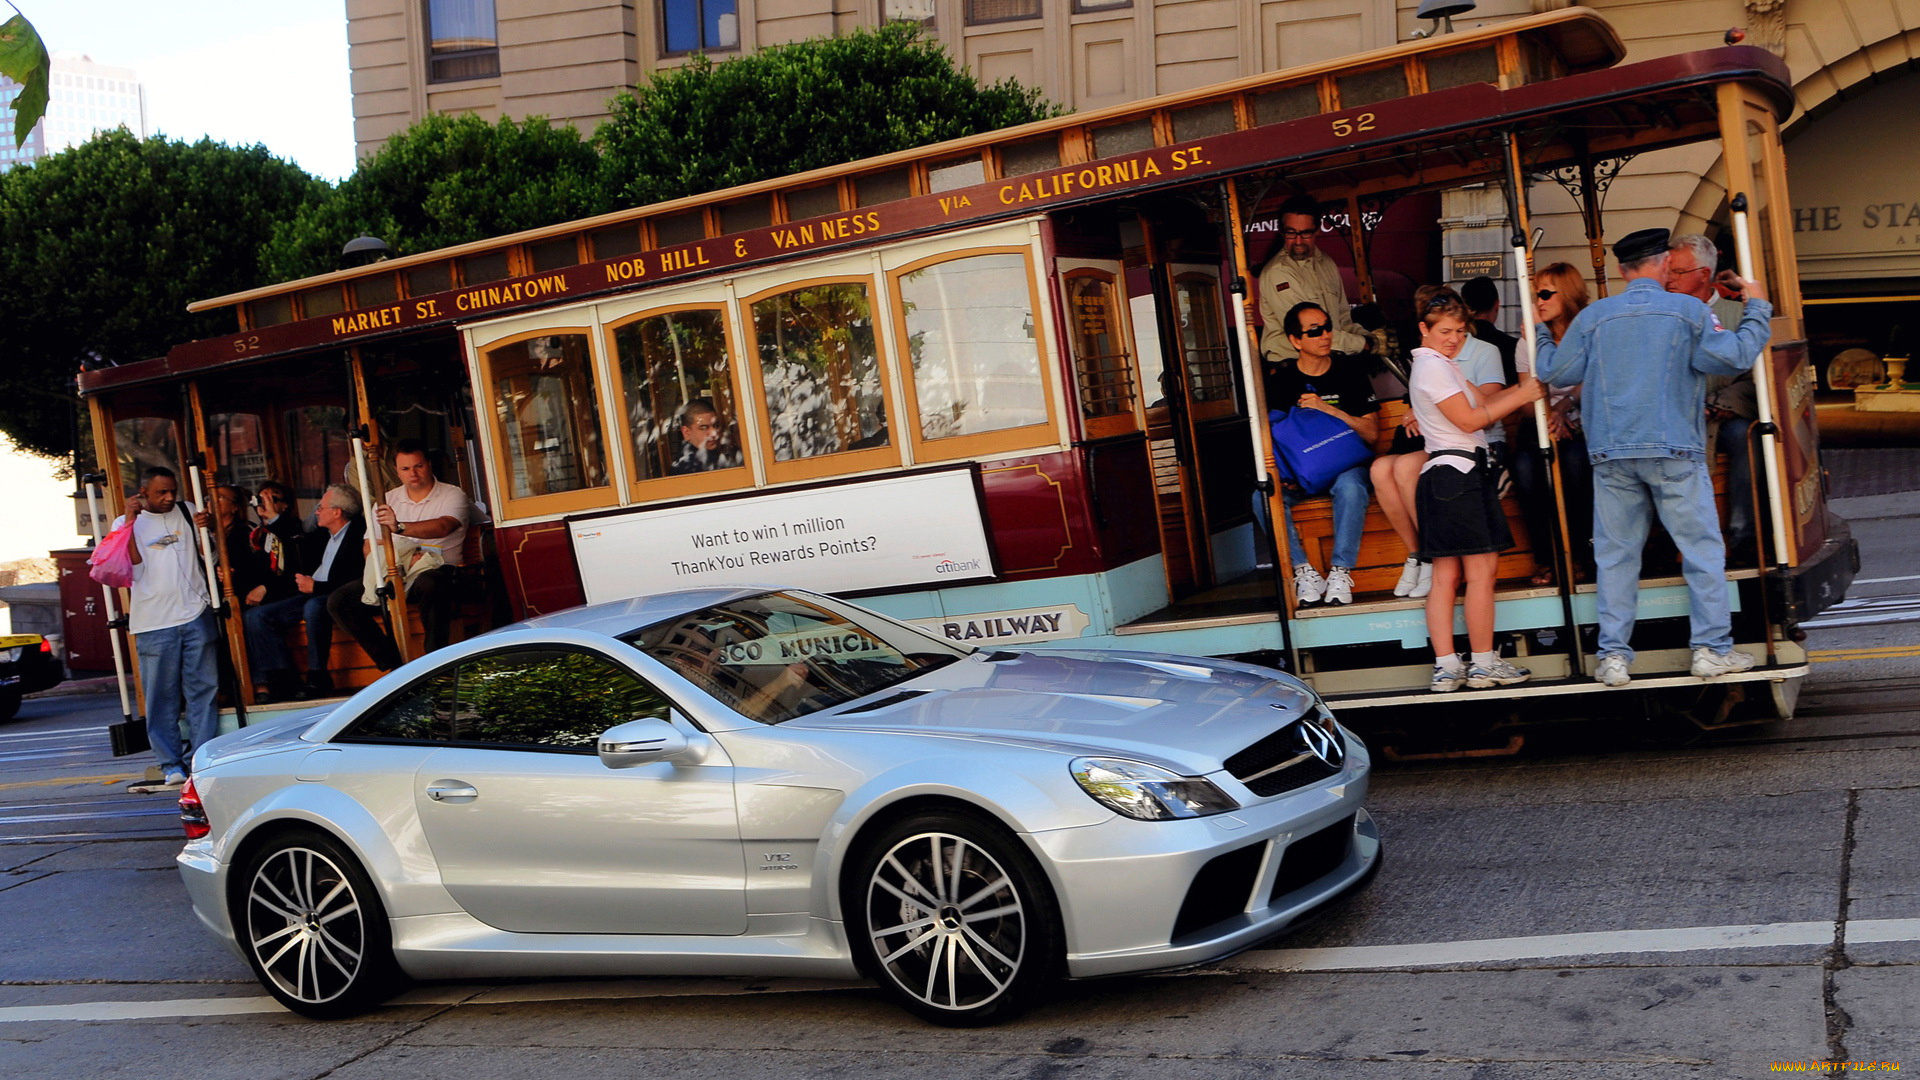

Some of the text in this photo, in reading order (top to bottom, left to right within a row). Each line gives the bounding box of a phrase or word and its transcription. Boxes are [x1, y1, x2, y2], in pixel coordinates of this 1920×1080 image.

[1331, 112, 1377, 137] 52
[1793, 206, 1842, 232] HE
[332, 145, 1212, 336] MARKET ST. CHINATOWN NOB HILL & VAN NESS VIA CALIFORNIA ST.
[233, 335, 260, 353] 52
[691, 516, 845, 549] Want to win 1 million
[750, 546, 815, 566] Rewards
[819, 536, 877, 557] Points?
[935, 558, 981, 574] citibank
[1368, 618, 1426, 631] TWO STAN
[719, 641, 763, 664] SCO
[943, 612, 1063, 641] RAILWAY
[764, 852, 791, 862] V12
